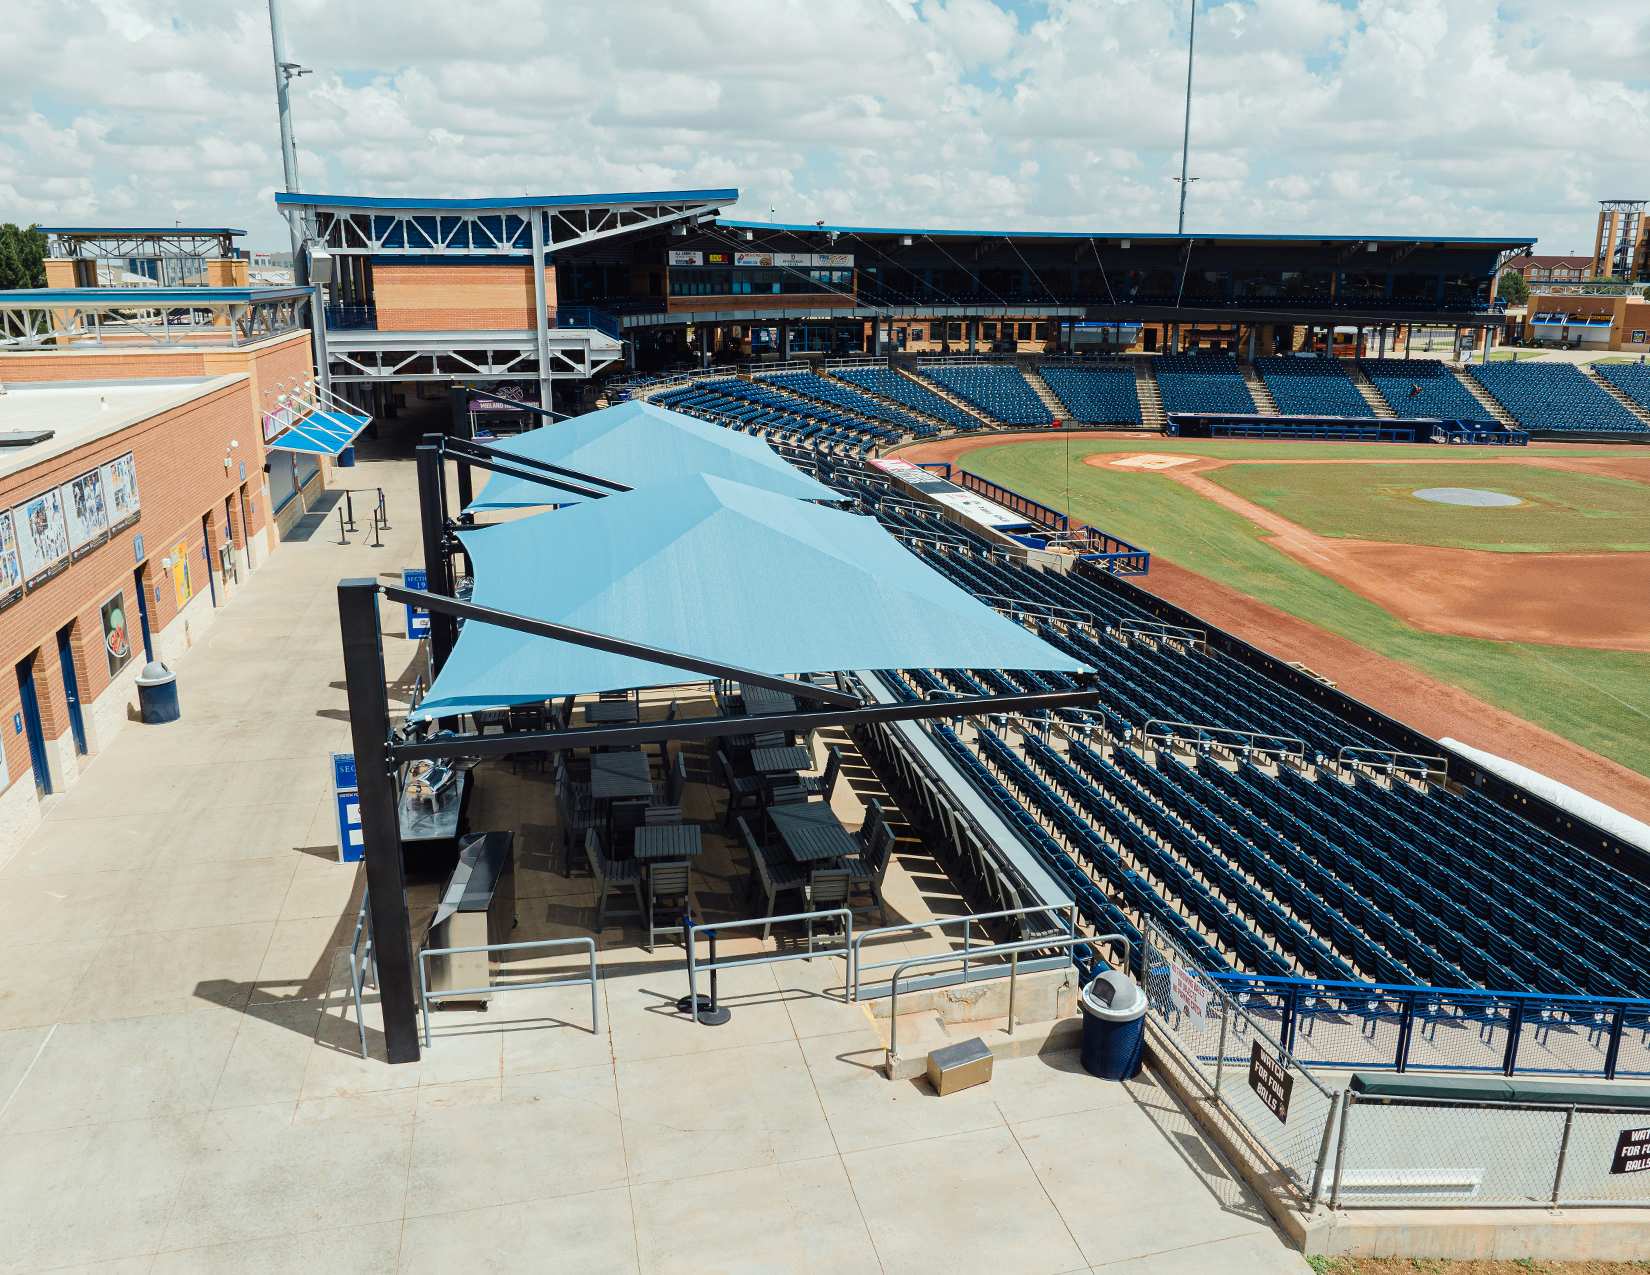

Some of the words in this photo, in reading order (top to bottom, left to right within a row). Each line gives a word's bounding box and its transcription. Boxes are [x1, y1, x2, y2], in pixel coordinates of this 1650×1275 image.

[1254, 1060, 1269, 1083] FOR
[1268, 1076, 1285, 1102] FOUL
[1260, 1048, 1285, 1082] WATCH
[1256, 1081, 1278, 1111] BALLS
[1621, 1146, 1640, 1157] FOR
